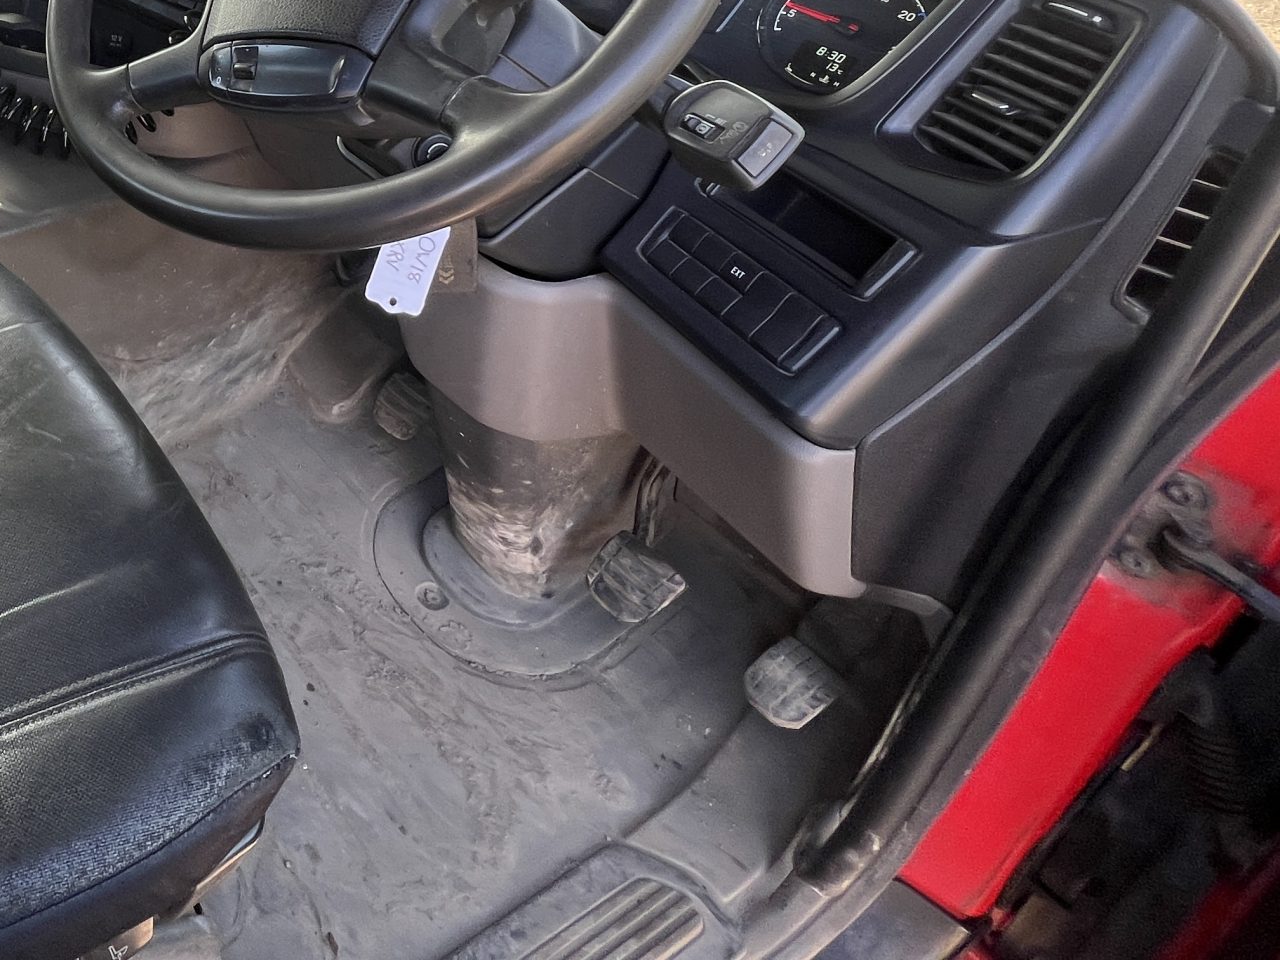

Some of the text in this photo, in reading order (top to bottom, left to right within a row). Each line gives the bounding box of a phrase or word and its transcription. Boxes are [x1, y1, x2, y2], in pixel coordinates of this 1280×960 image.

[787, 8, 797, 18] 5
[897, 10, 916, 22] 20
[816, 46, 847, 63] 8:30
[731, 266, 746, 279] EXT
